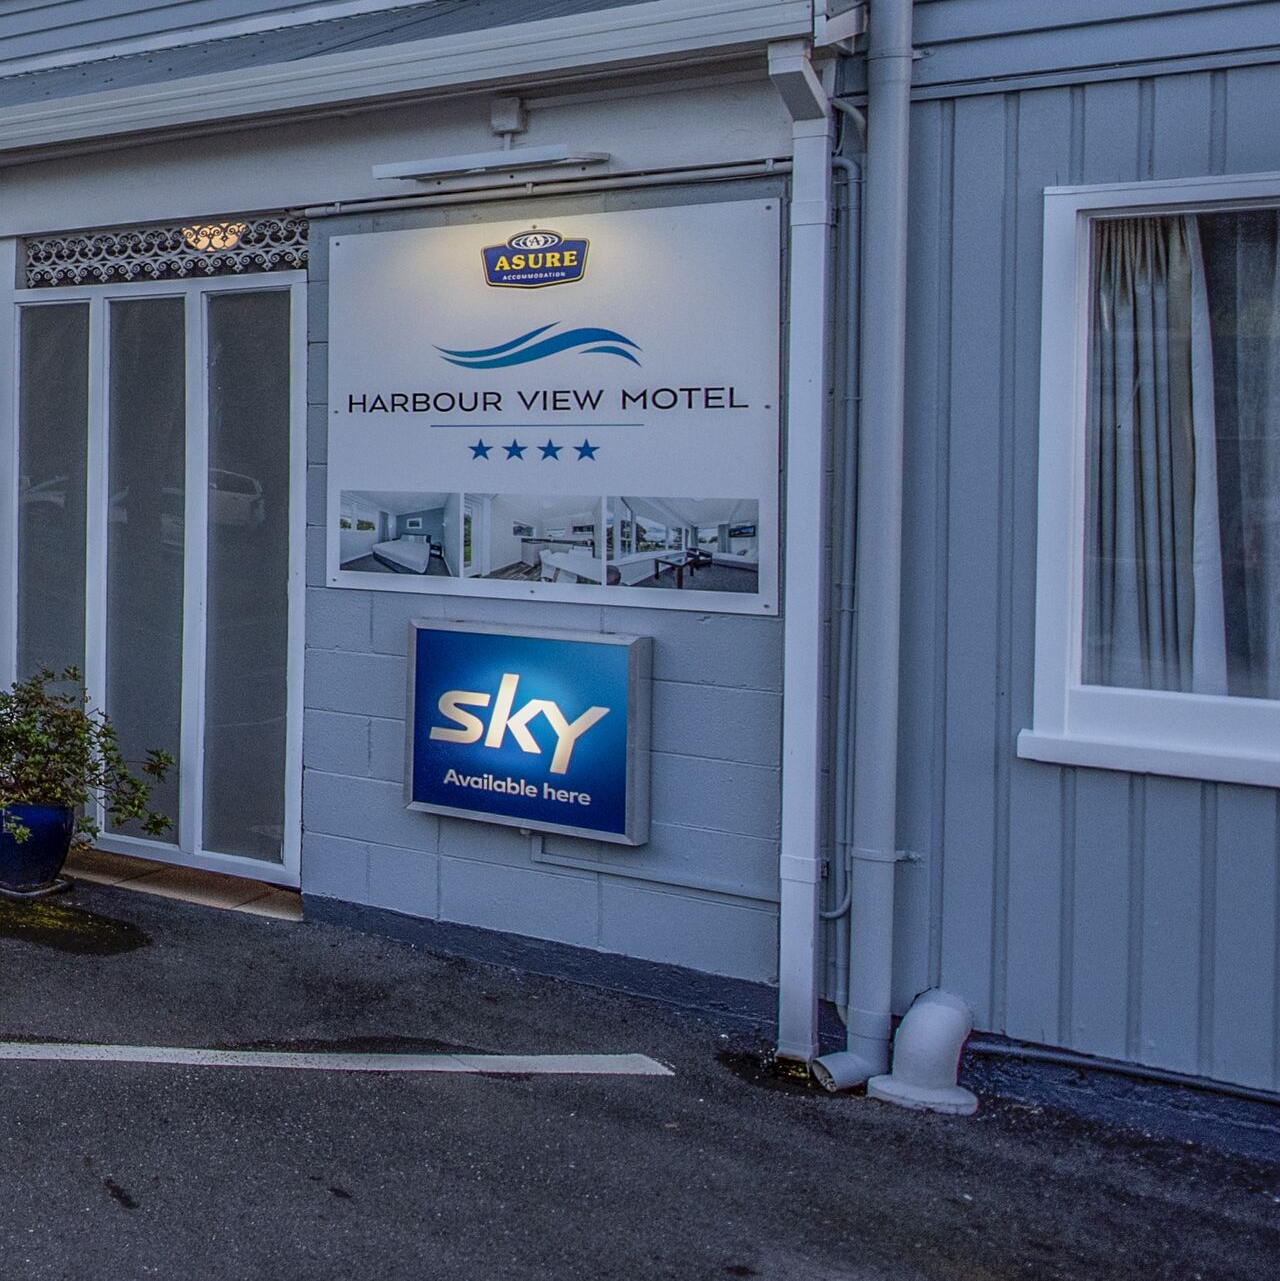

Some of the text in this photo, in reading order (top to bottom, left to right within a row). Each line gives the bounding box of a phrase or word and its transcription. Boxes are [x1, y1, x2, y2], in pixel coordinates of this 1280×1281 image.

[494, 251, 578, 271] ASURE
[502, 272, 566, 281] ACCOMMODATION
[347, 387, 749, 414] HARBOUR VIEW MOTEL
[443, 769, 591, 806] Available here
